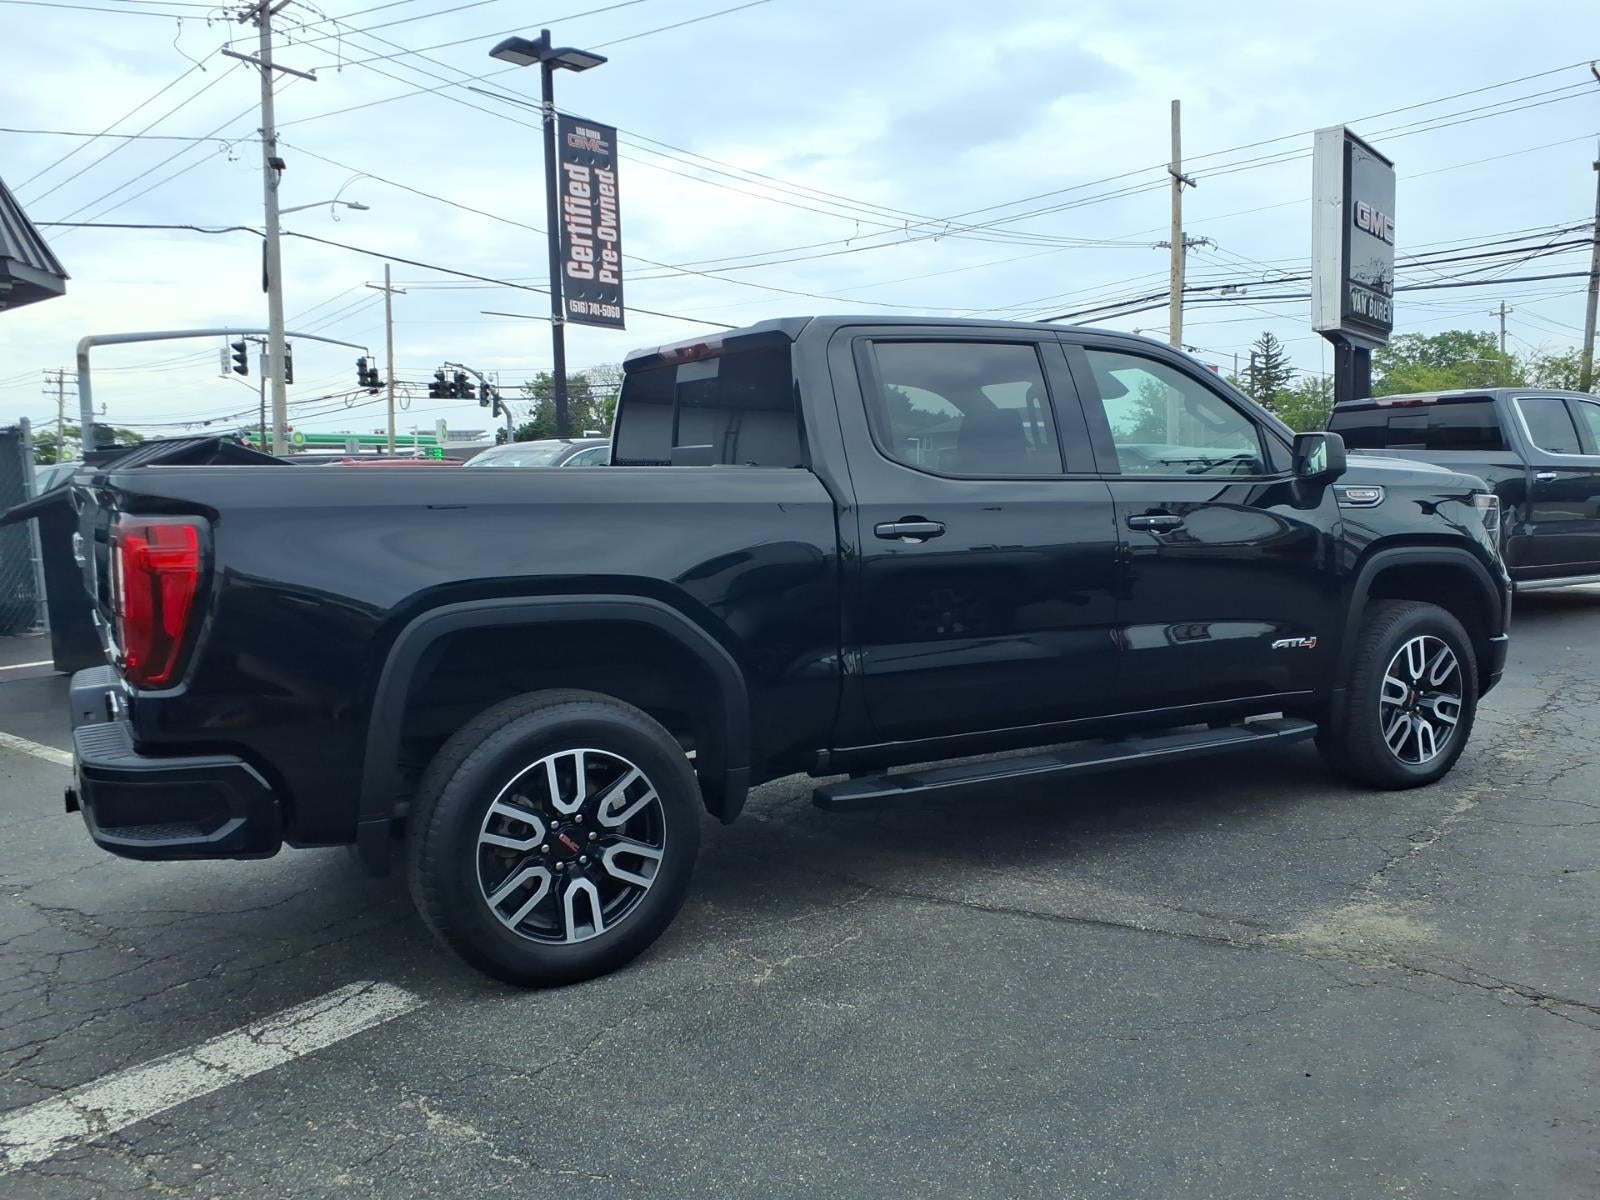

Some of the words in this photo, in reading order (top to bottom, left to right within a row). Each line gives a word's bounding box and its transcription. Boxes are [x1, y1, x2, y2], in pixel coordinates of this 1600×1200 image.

[567, 132, 609, 155] GMC
[564, 162, 594, 280] Certified
[594, 167, 619, 285] Pre-Owned
[1354, 200, 1394, 246] GMC
[569, 299, 588, 314] (516)
[1352, 292, 1367, 315] VAN
[1369, 298, 1393, 324] BUREN
[1271, 636, 1317, 649] AT4
[559, 833, 580, 852] GMC
